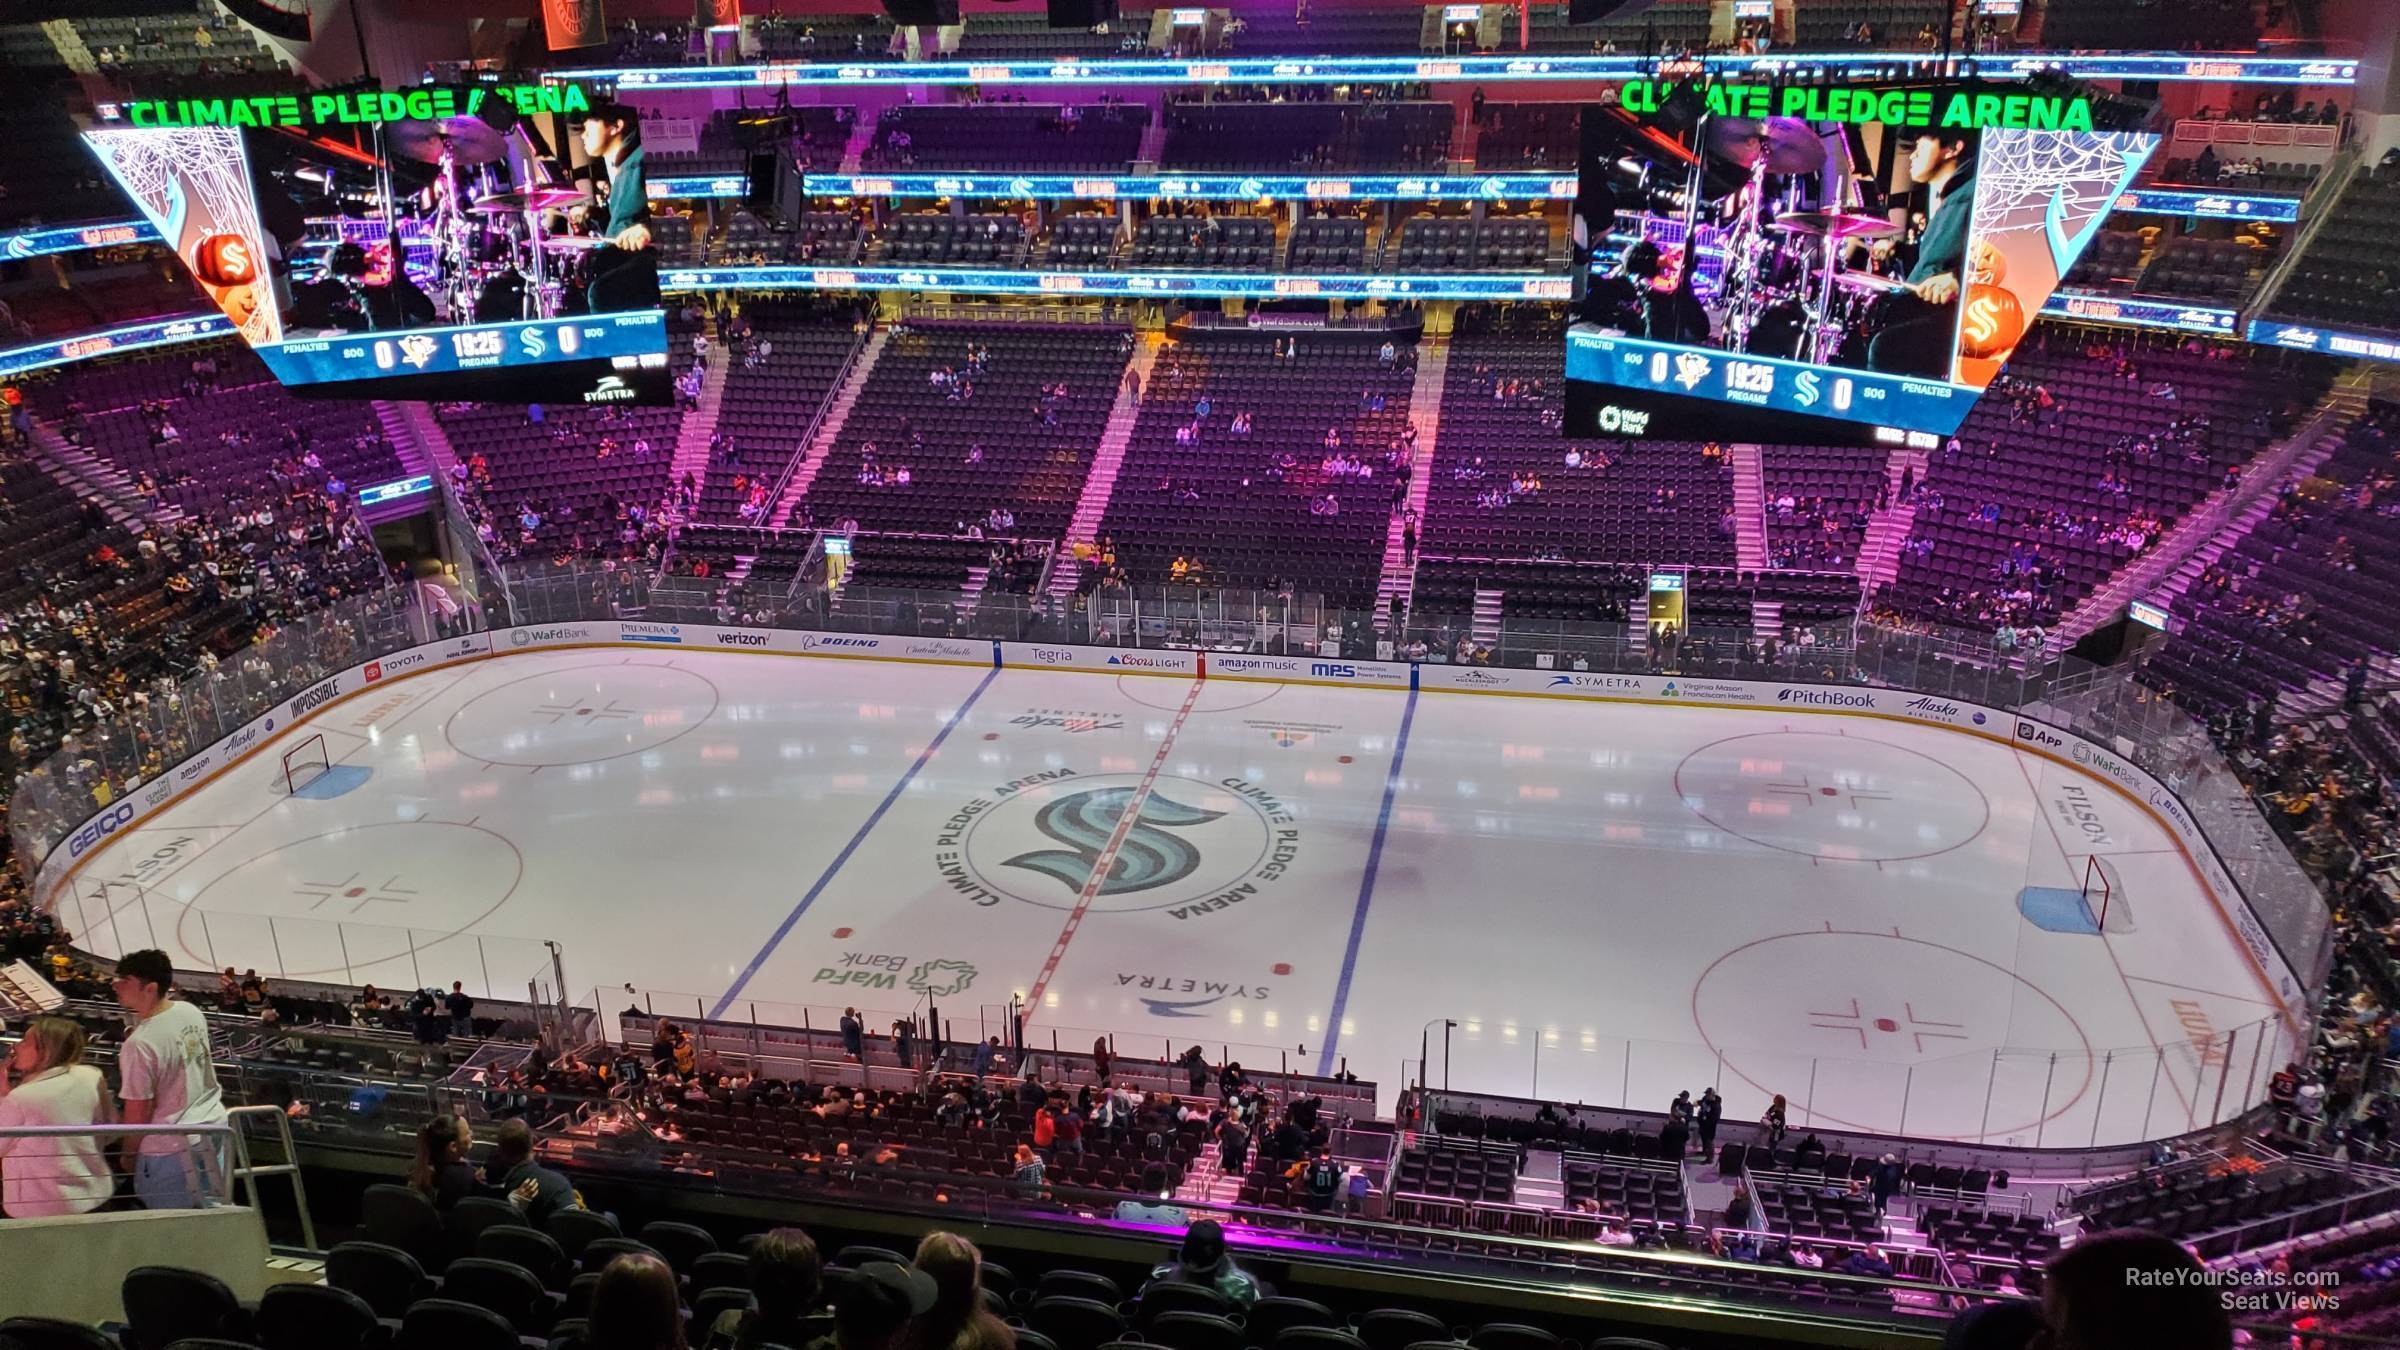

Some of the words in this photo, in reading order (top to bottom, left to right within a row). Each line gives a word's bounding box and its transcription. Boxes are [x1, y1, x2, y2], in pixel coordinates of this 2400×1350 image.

[131, 97, 300, 127] CLIMATE
[312, 89, 455, 124] PLEDGE
[1621, 80, 1770, 118] CLATE
[1783, 88, 1932, 126] PLEDGE
[1941, 93, 2092, 132] ARENA
[616, 315, 658, 327] PENALTIES
[283, 341, 330, 354] PENALTIES
[343, 347, 365, 359] SOG
[374, 341, 394, 369] 0
[452, 331, 502, 357] 19:25
[558, 325, 577, 353] 0
[584, 328, 604, 339] SOG
[458, 356, 500, 368] PREGAME
[1574, 338, 1615, 352] PENALTIES
[1624, 352, 1644, 365] SOG
[1651, 351, 1670, 383] 0
[1726, 361, 1775, 393] 19:25
[1834, 378, 1853, 410] 0
[1863, 386, 1886, 400] SOG
[1902, 382, 1952, 398] PENALTIES
[584, 389, 635, 402] SYMETRA
[1726, 389, 1768, 405] PREGAME
[621, 623, 665, 634] PREMERA
[717, 632, 767, 647] verizon
[820, 638, 880, 648] BOEING
[384, 653, 425, 672] TOYOTA
[1032, 648, 1073, 664] Tegria
[1121, 653, 1154, 666] Coors
[1155, 659, 1187, 668] LIGHT
[1218, 658, 1260, 671] amazon
[1262, 659, 1298, 671] music
[1576, 676, 1641, 689] SYMETRA
[289, 678, 340, 720] IMPOSSIBLE
[1793, 689, 1876, 709] PitchBook
[1906, 695, 1958, 716] Alaska
[223, 727, 256, 755] Alaska
[180, 756, 210, 780] amazon
[994, 767, 1077, 797] ARENA
[1221, 777, 1294, 826] CLIMATE
[937, 797, 992, 846] PLEDGE
[2062, 785, 2113, 845] FILSON
[2163, 799, 2194, 838] BOEING
[69, 802, 134, 858] GEICO
[1256, 828, 1298, 882] PLEDGE
[937, 849, 1000, 907] CLIMATE
[1167, 882, 1258, 921] ARENA
[838, 951, 908, 972] Bank
[812, 968, 898, 990] WaFd
[1118, 973, 1271, 1001] SYMETRA
